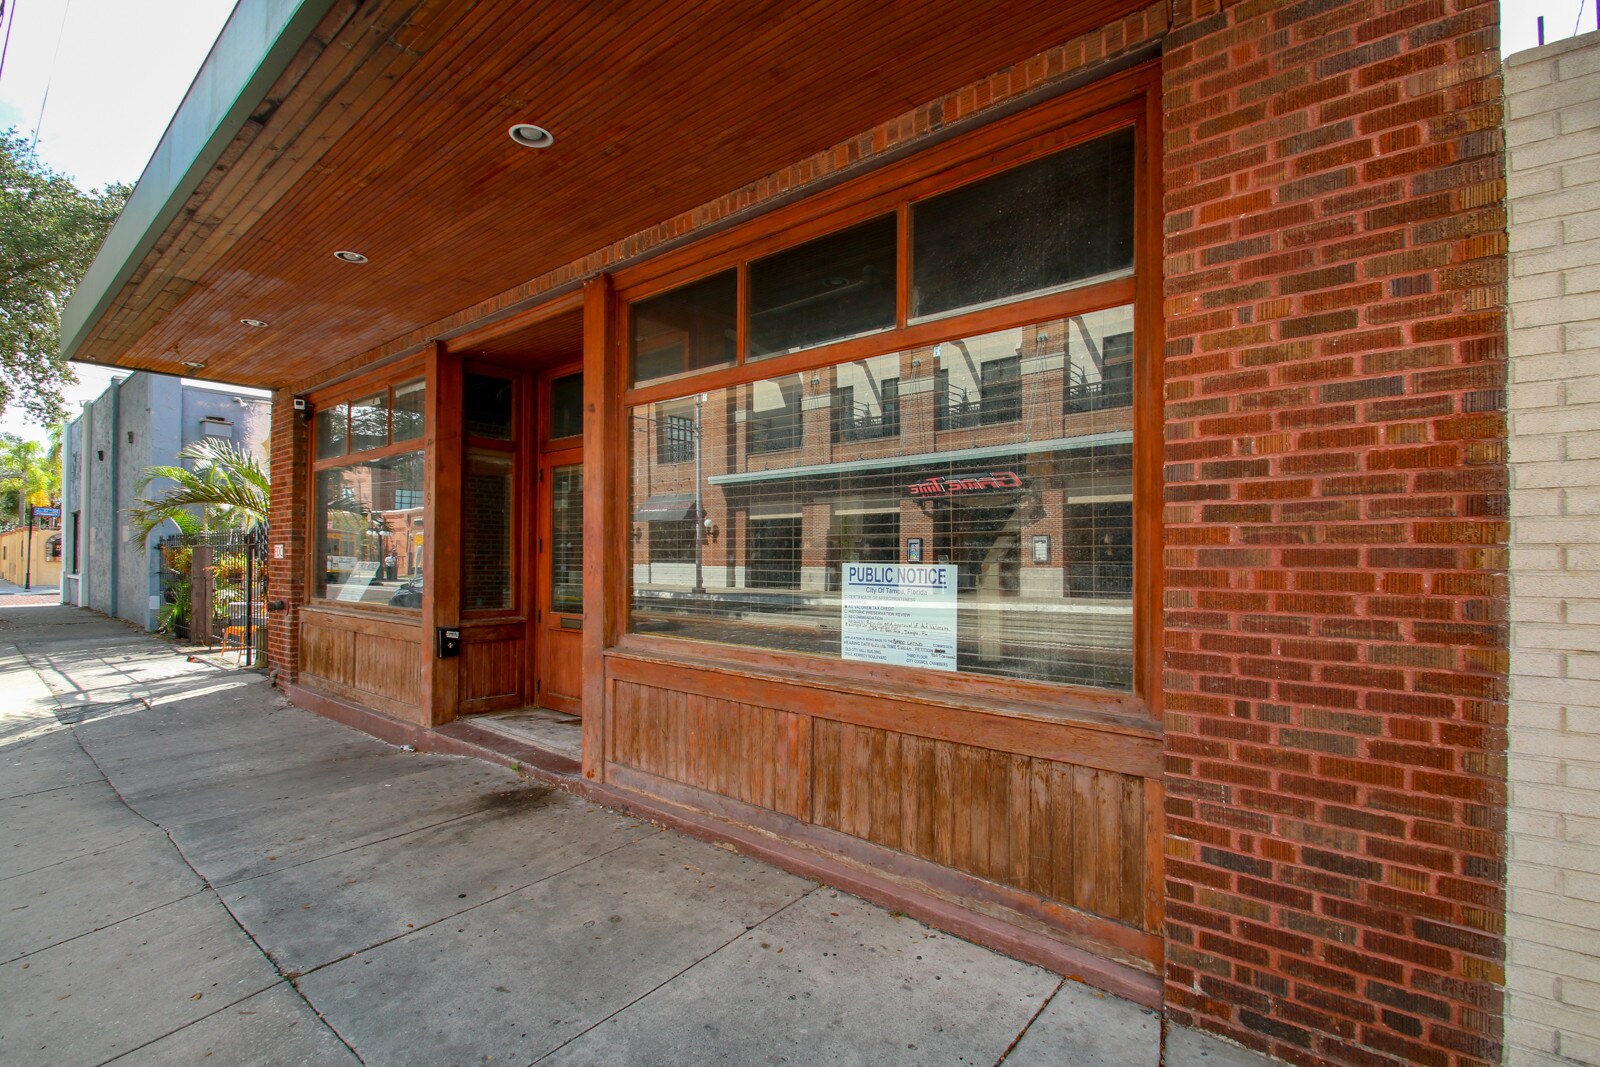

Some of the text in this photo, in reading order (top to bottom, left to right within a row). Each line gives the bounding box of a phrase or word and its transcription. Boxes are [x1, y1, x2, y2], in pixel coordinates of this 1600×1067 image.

[849, 567, 946, 584] PUBLIC NOTICE
[886, 588, 905, 596] Tampa,
